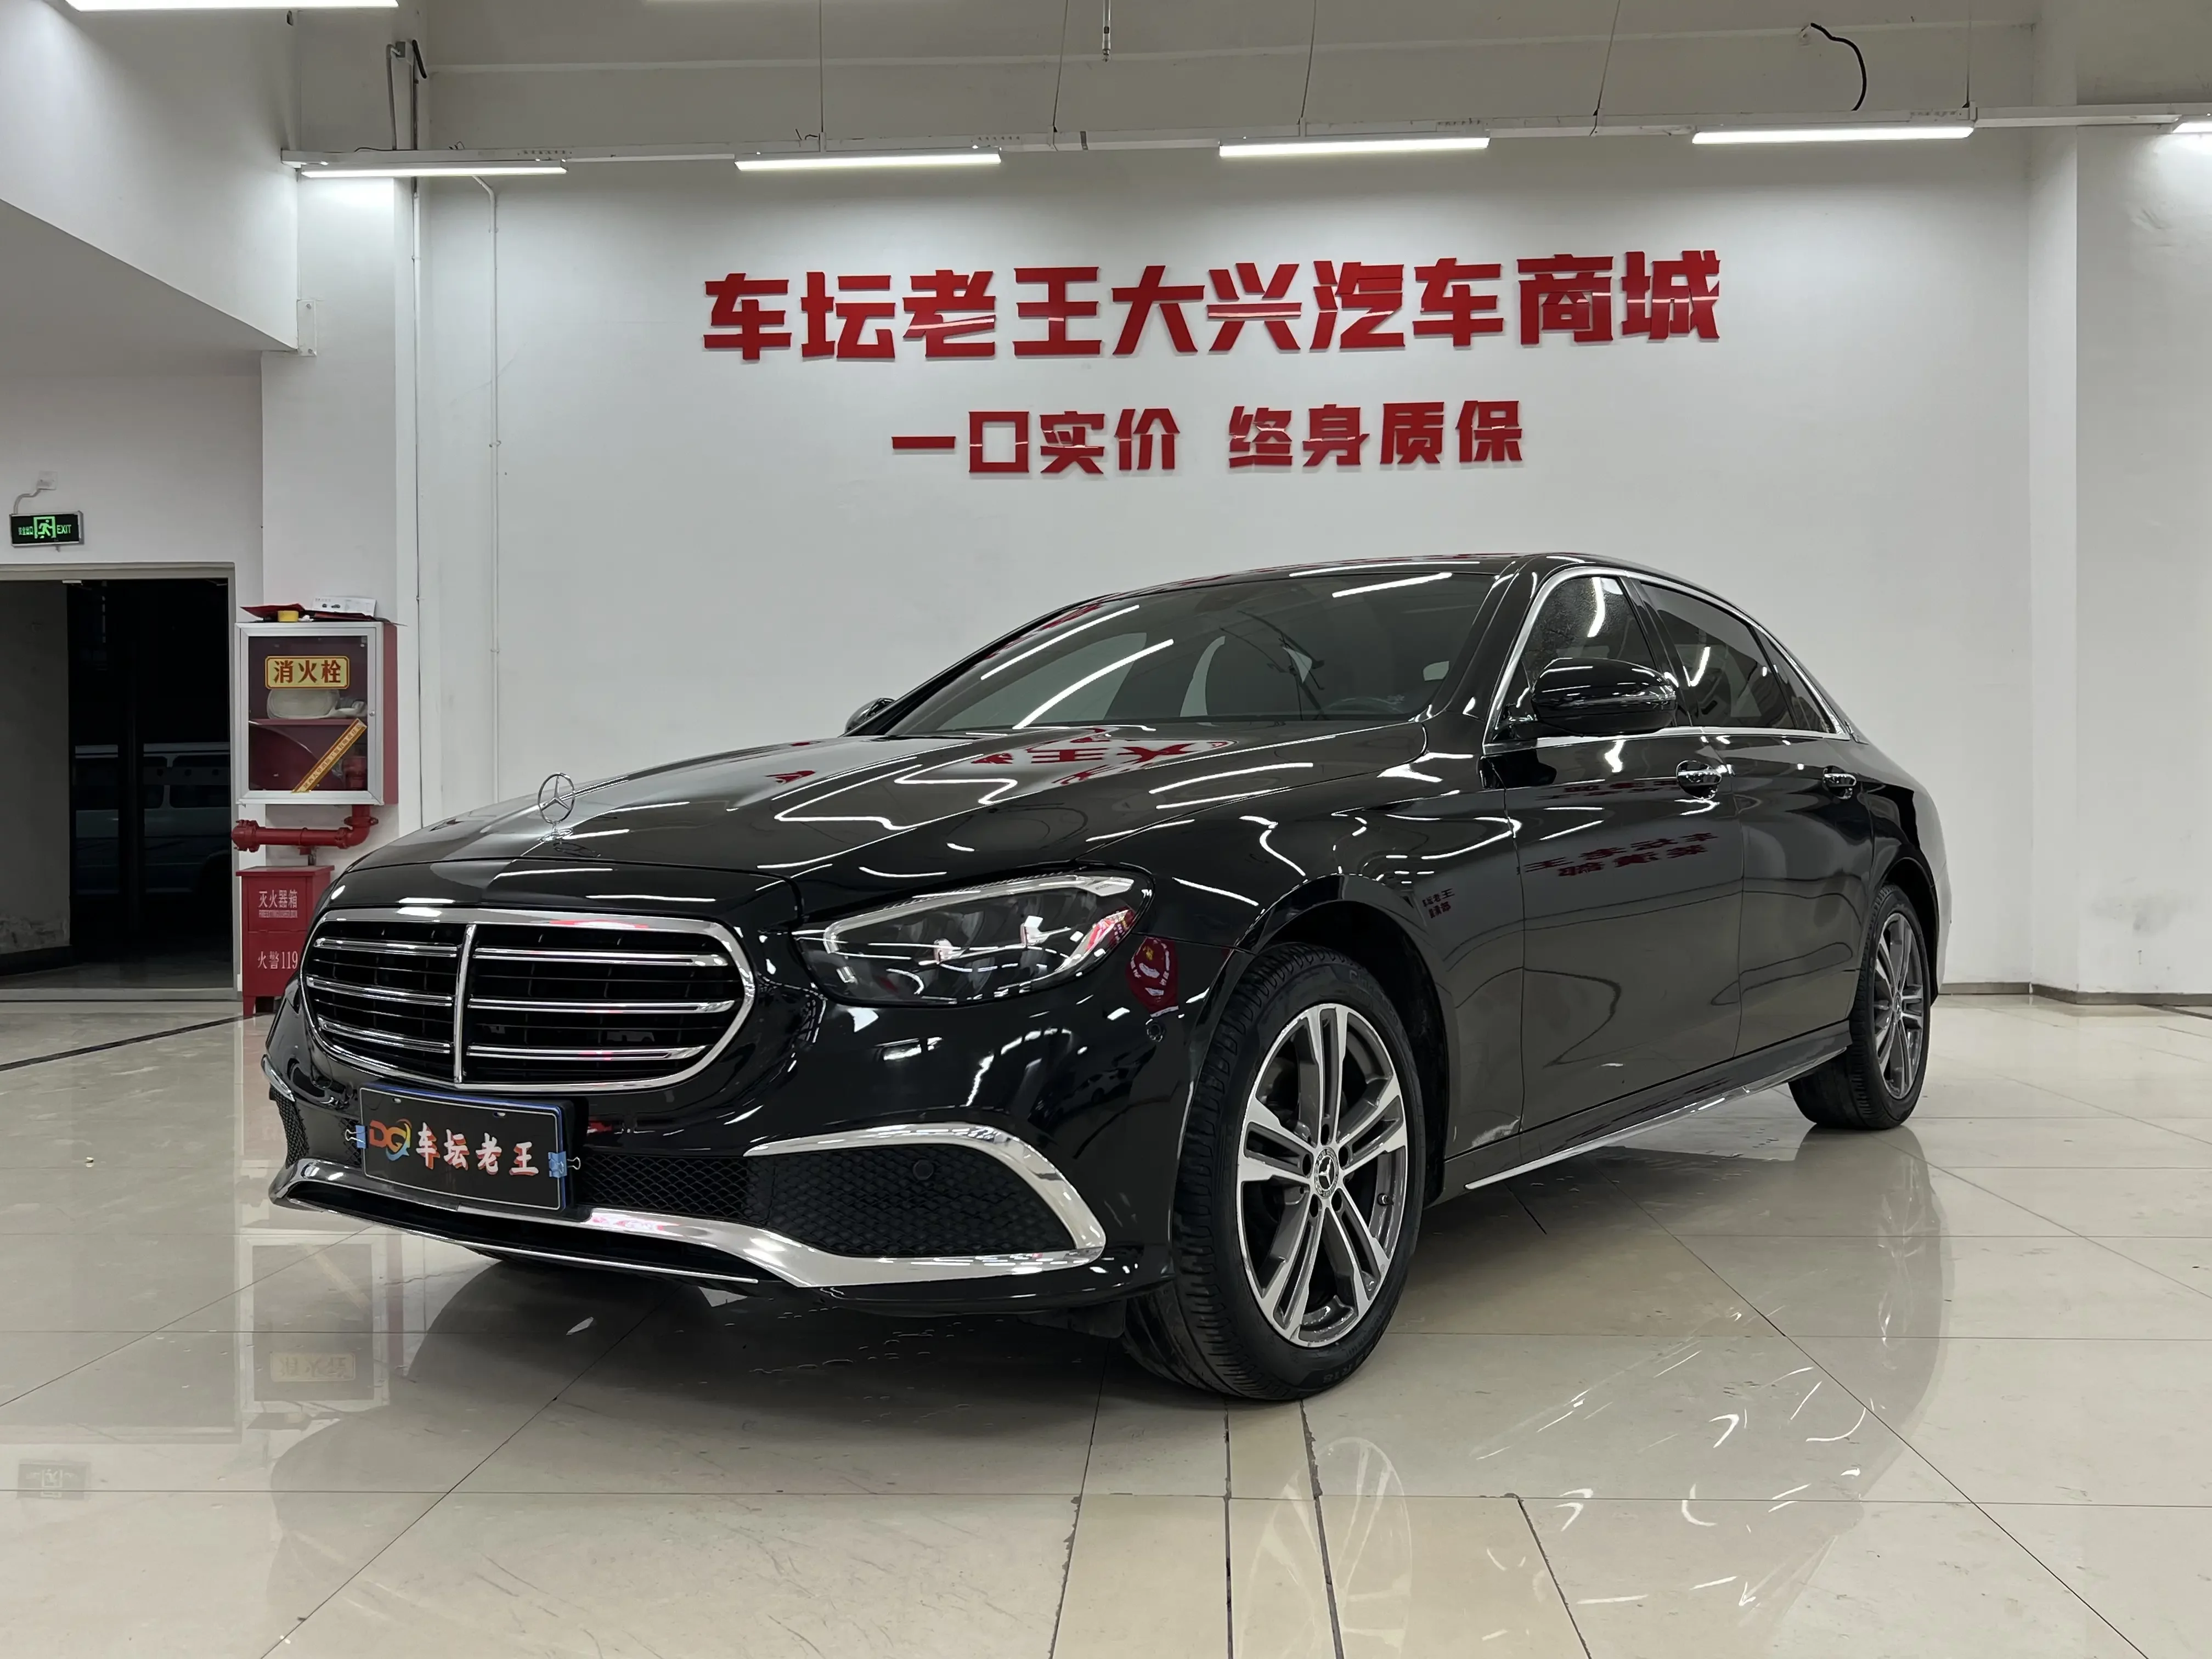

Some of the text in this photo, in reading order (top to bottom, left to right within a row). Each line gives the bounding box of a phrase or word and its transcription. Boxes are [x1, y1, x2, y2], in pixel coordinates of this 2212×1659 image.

[704, 249, 1722, 360] 车坛老王大兴汽车商城
[891, 400, 1523, 473] 一口实价 终身质保
[57, 524, 71, 534] EXIT
[274, 660, 341, 683] 消火栓
[258, 889, 298, 909] 灭火器箱
[415, 1121, 540, 1177] 车坛老王
